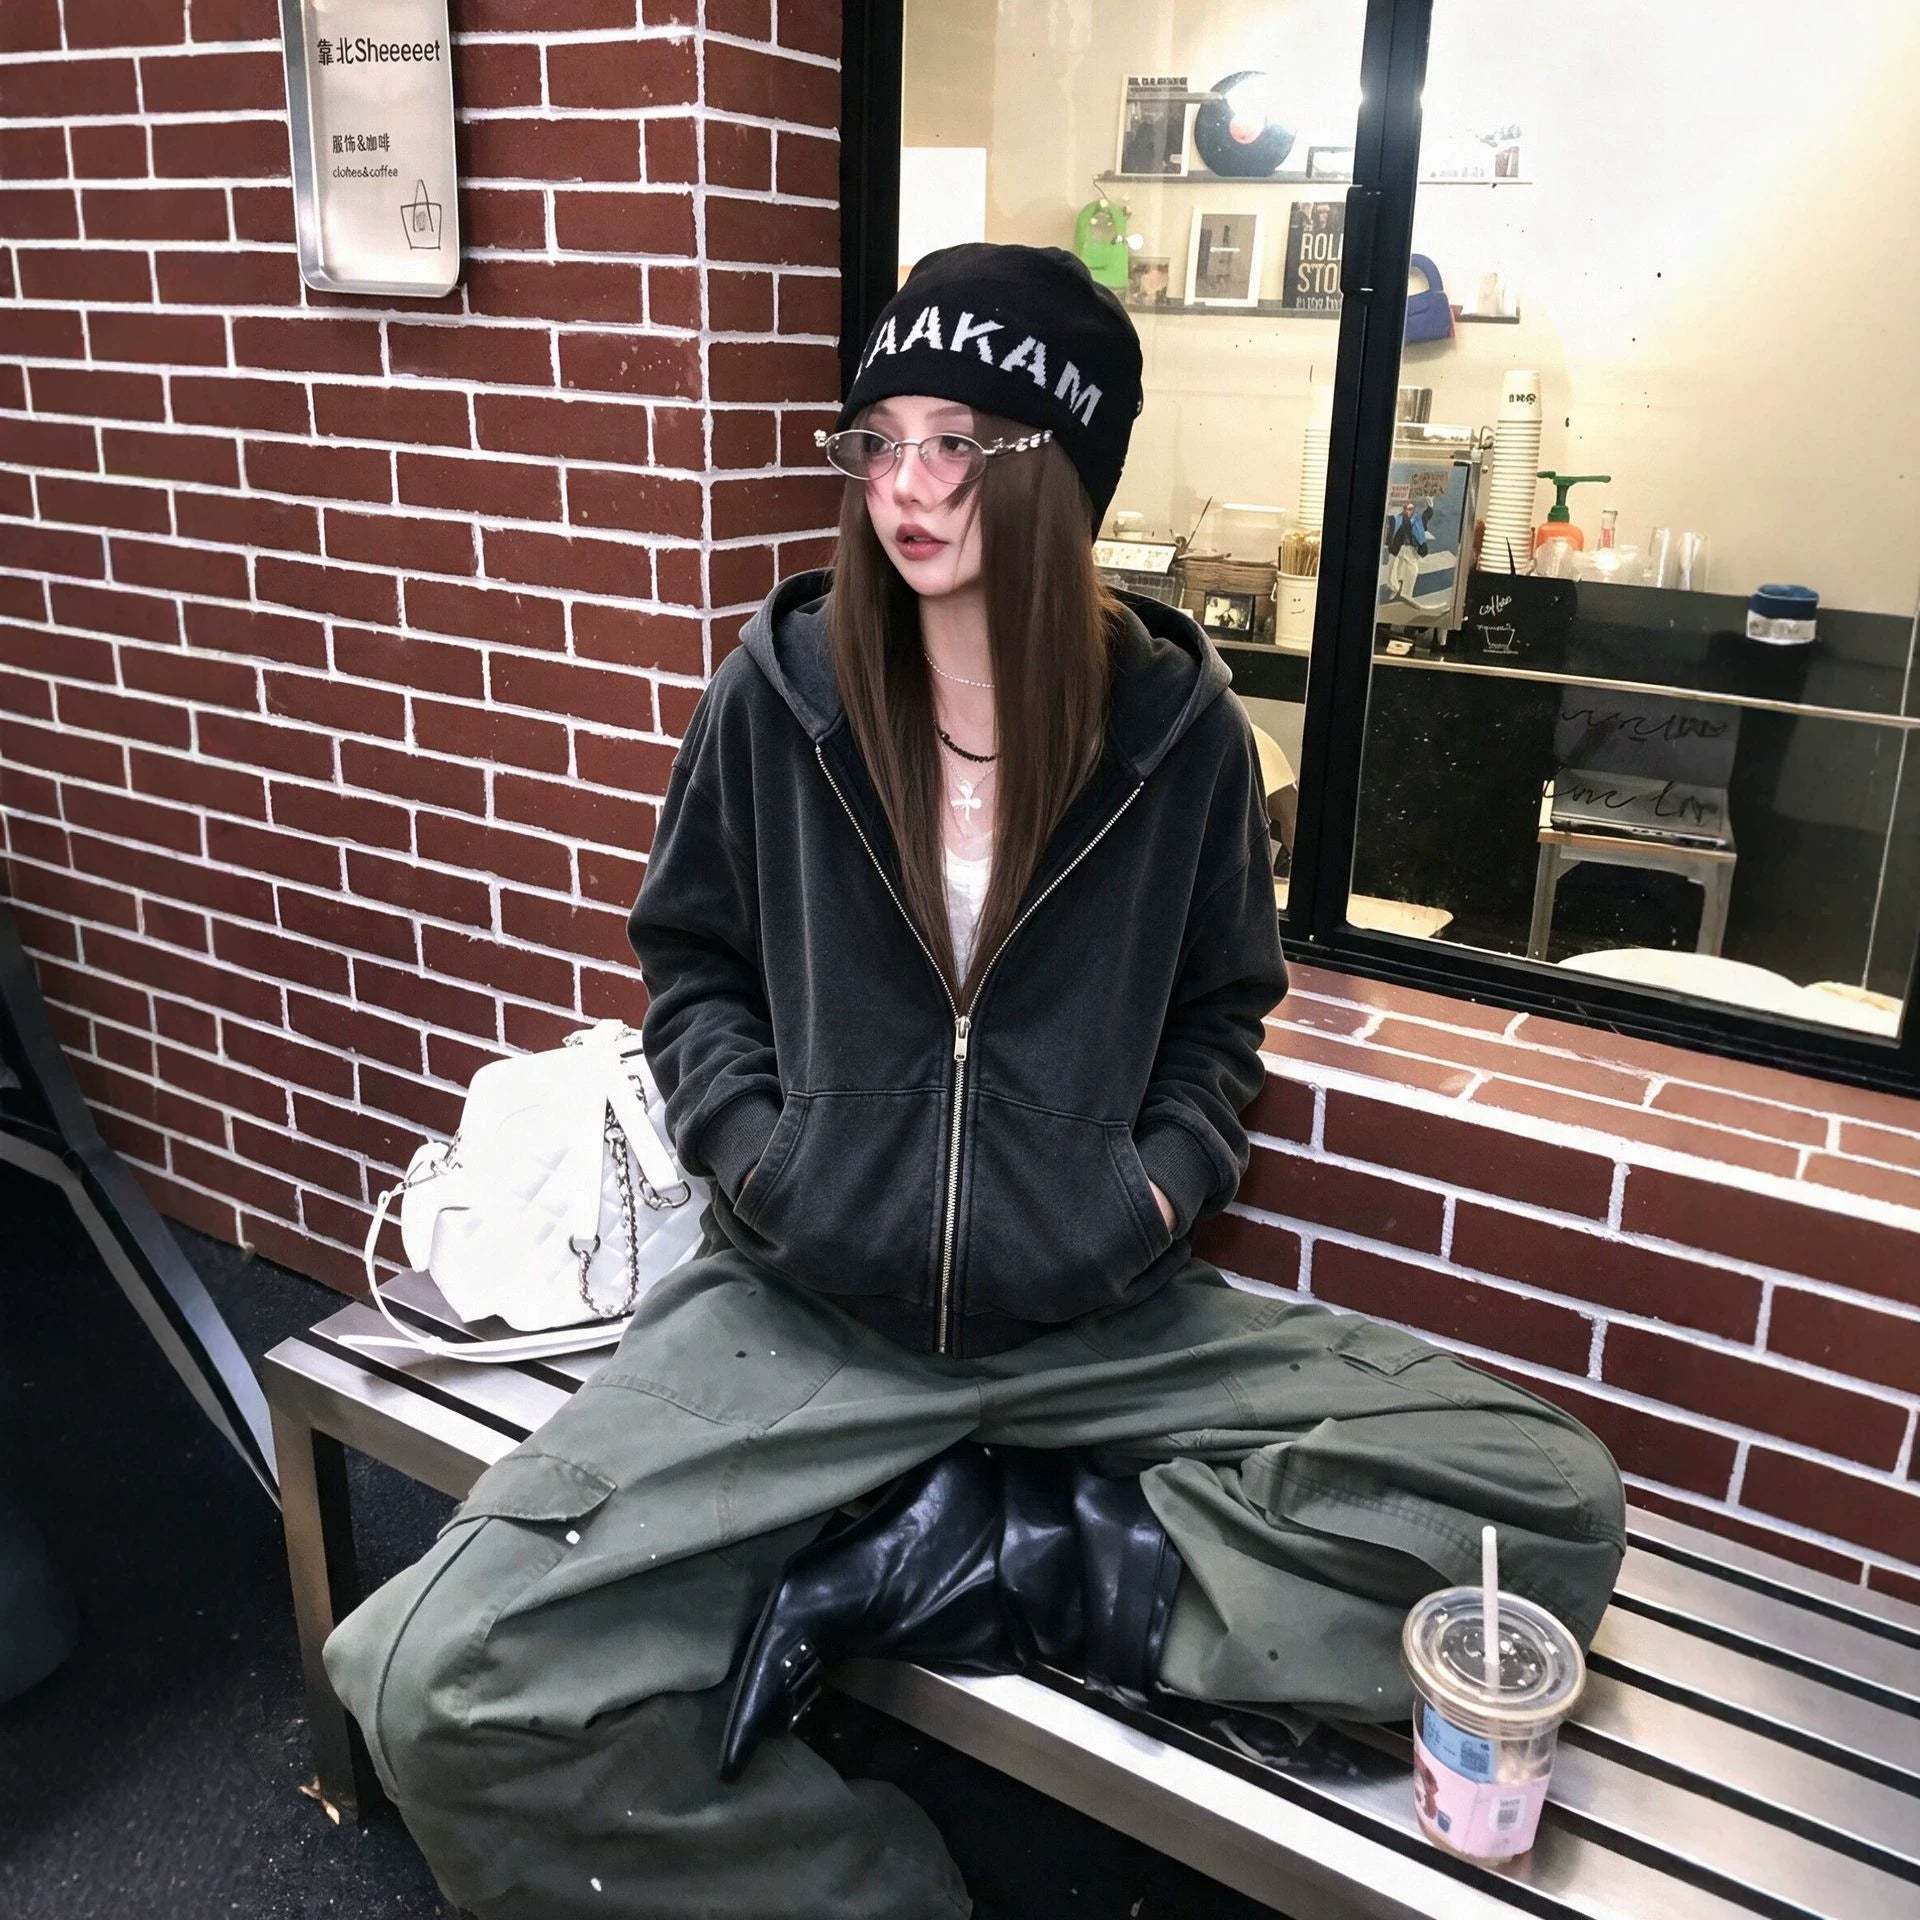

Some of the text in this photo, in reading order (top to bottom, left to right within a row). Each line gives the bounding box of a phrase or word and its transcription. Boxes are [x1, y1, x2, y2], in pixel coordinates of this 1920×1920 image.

[317, 37, 440, 66] 靠北Sheeeeet
[332, 132, 390, 154] 服饰&咖啡
[854, 306, 1103, 427] AAKAM
